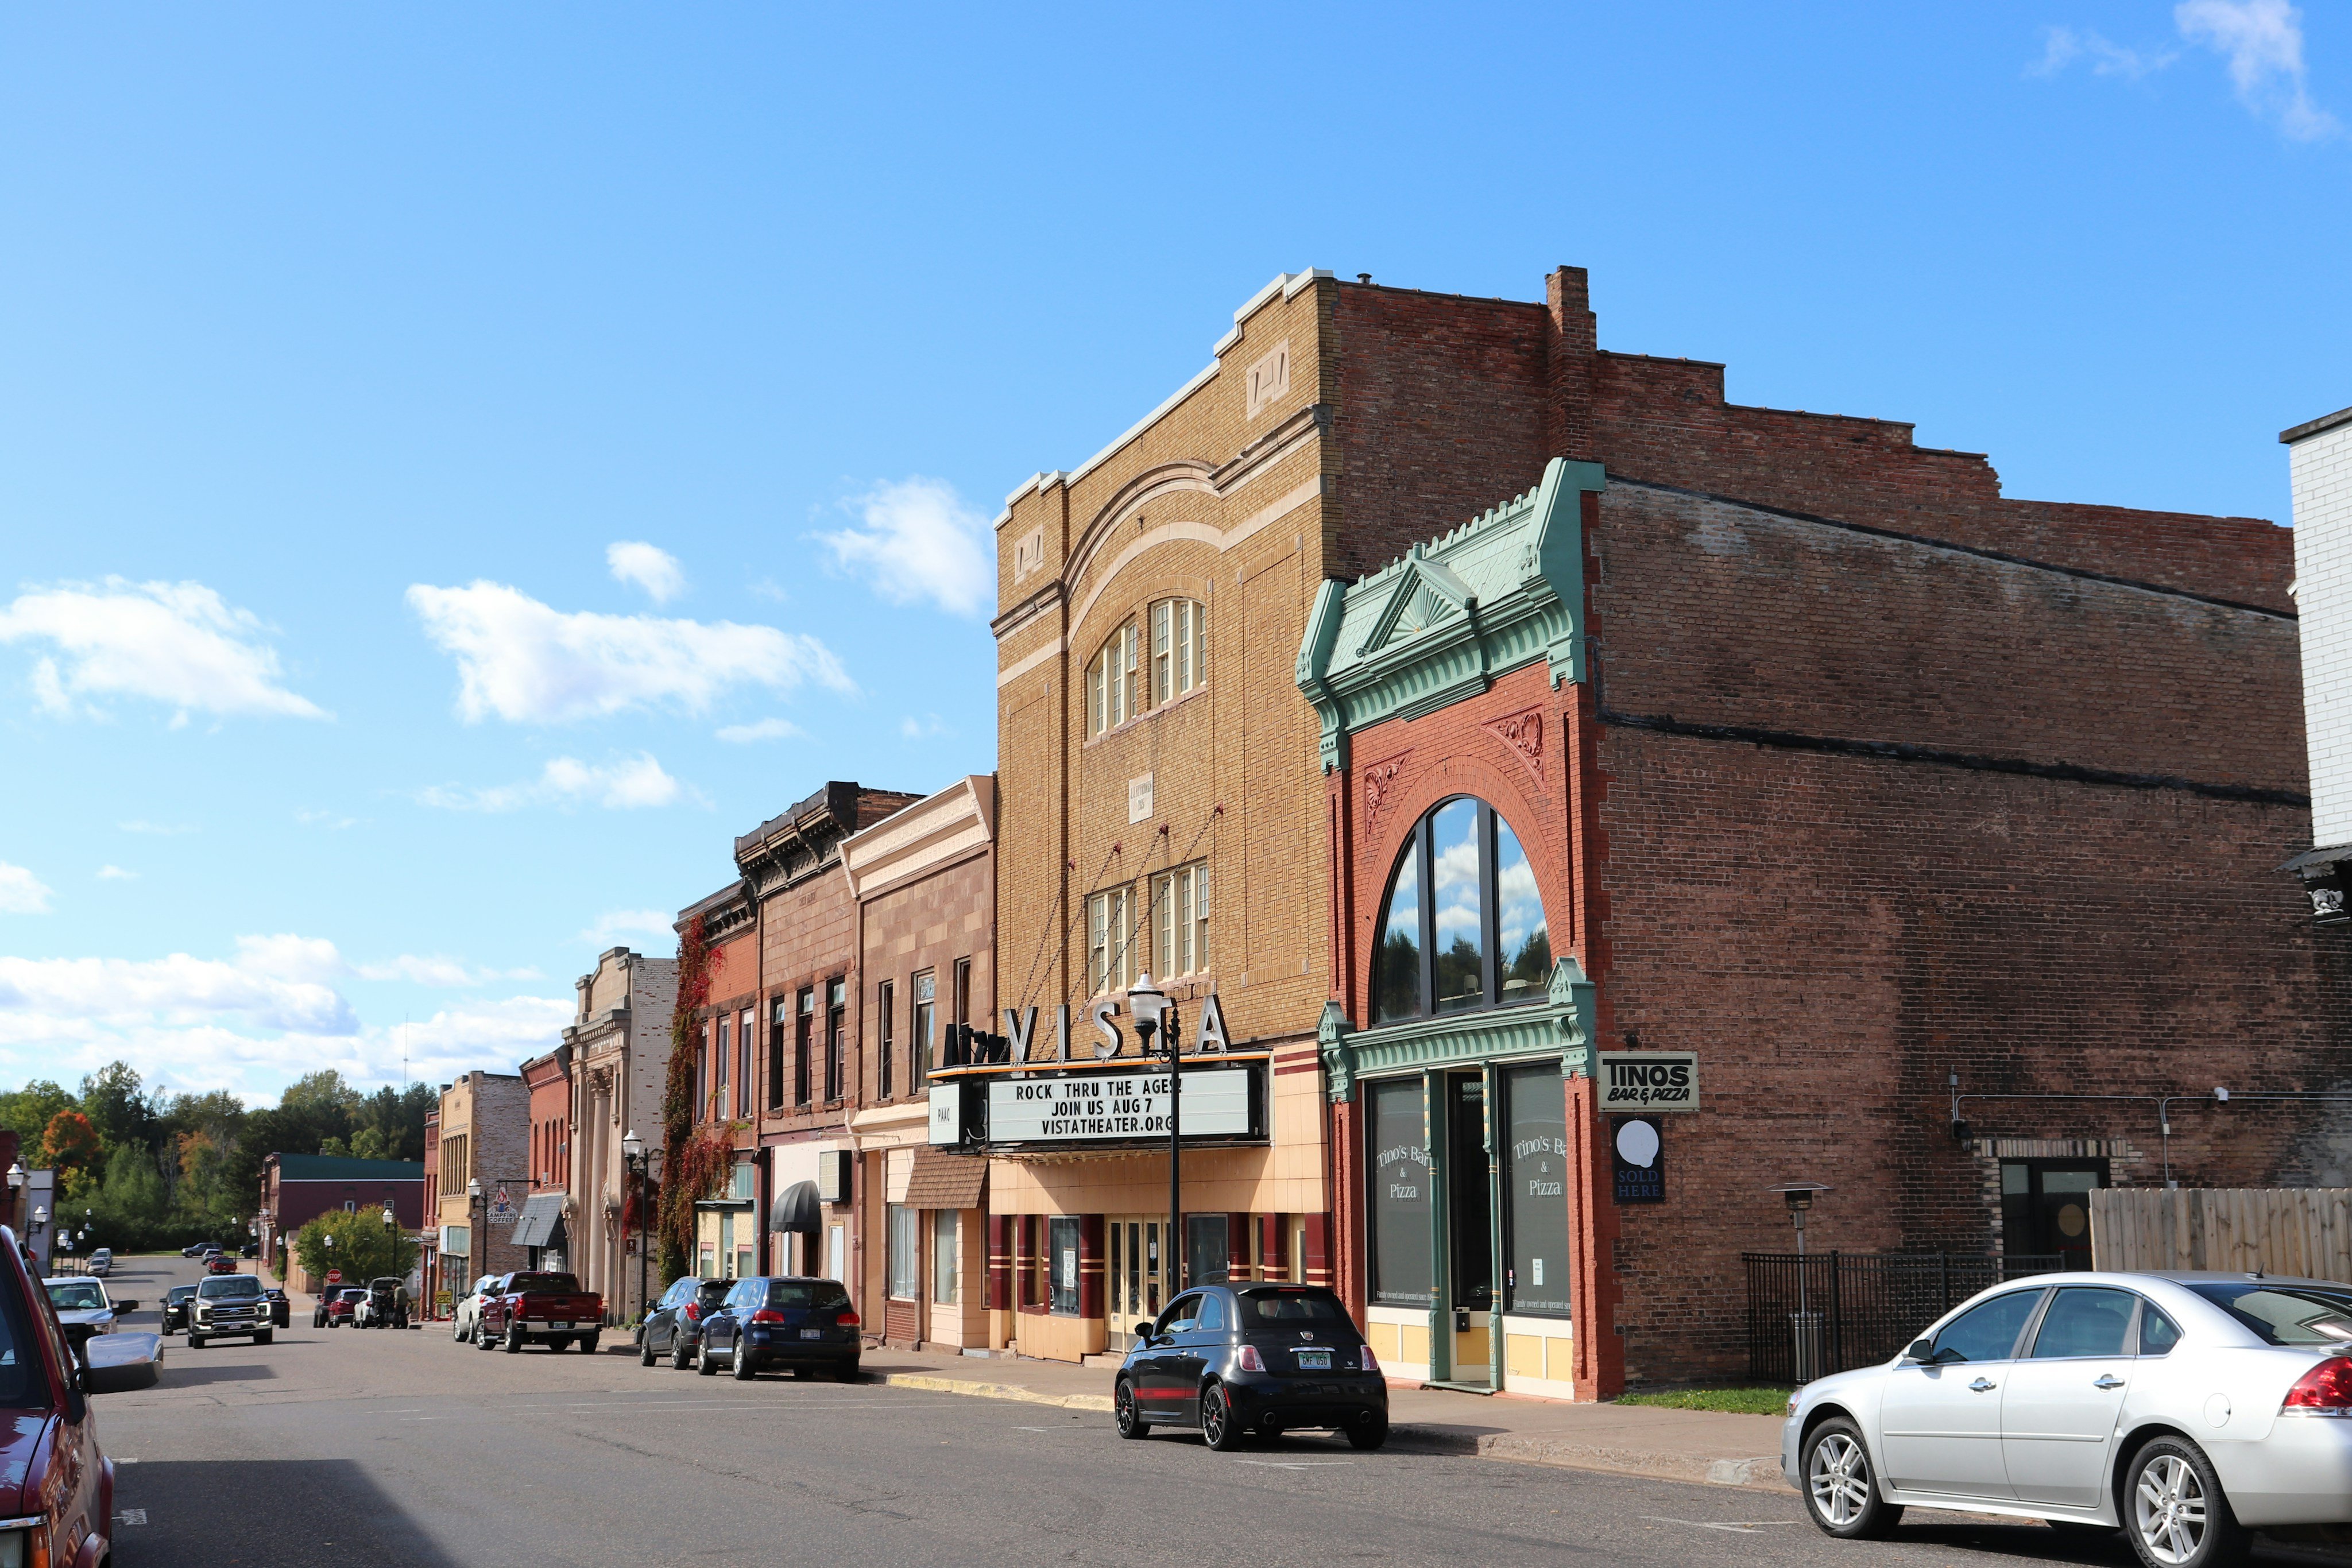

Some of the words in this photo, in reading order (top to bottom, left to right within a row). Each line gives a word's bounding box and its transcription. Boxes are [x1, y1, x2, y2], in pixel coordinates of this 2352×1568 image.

[1003, 994, 1231, 1062] VISTA
[1603, 1059, 1692, 1087] TINOS
[1016, 1085, 1052, 1100] ROCK
[1065, 1083, 1099, 1098] THRU
[1108, 1081, 1132, 1096] THE
[1143, 1078, 1182, 1094] AGE!
[1607, 1087, 1638, 1101] BAR
[1640, 1087, 1649, 1105] &
[1650, 1087, 1690, 1101] PIZZA
[1051, 1102, 1081, 1116] JOIN
[1088, 1100, 1104, 1115] US
[1113, 1098, 1140, 1114] AUG
[1145, 1098, 1152, 1113] 7
[938, 1108, 950, 1122] PAAC
[1513, 1135, 1549, 1159] Tino's
[1377, 1145, 1407, 1168] Tino's
[1410, 1145, 1429, 1167] Bar
[1399, 1167, 1406, 1178] &
[1541, 1161, 1548, 1172] &
[1618, 1170, 1659, 1182] SOLD
[1390, 1183, 1416, 1198] Pizza
[1529, 1179, 1561, 1195] Pizza
[1618, 1185, 1661, 1197] HERE
[1377, 1290, 1387, 1300] Family
[1387, 1291, 1398, 1299] owned
[1405, 1292, 1418, 1302] operated
[1512, 1299, 1526, 1310] Family
[1526, 1299, 1539, 1308] owned
[1548, 1300, 1564, 1311] operated
